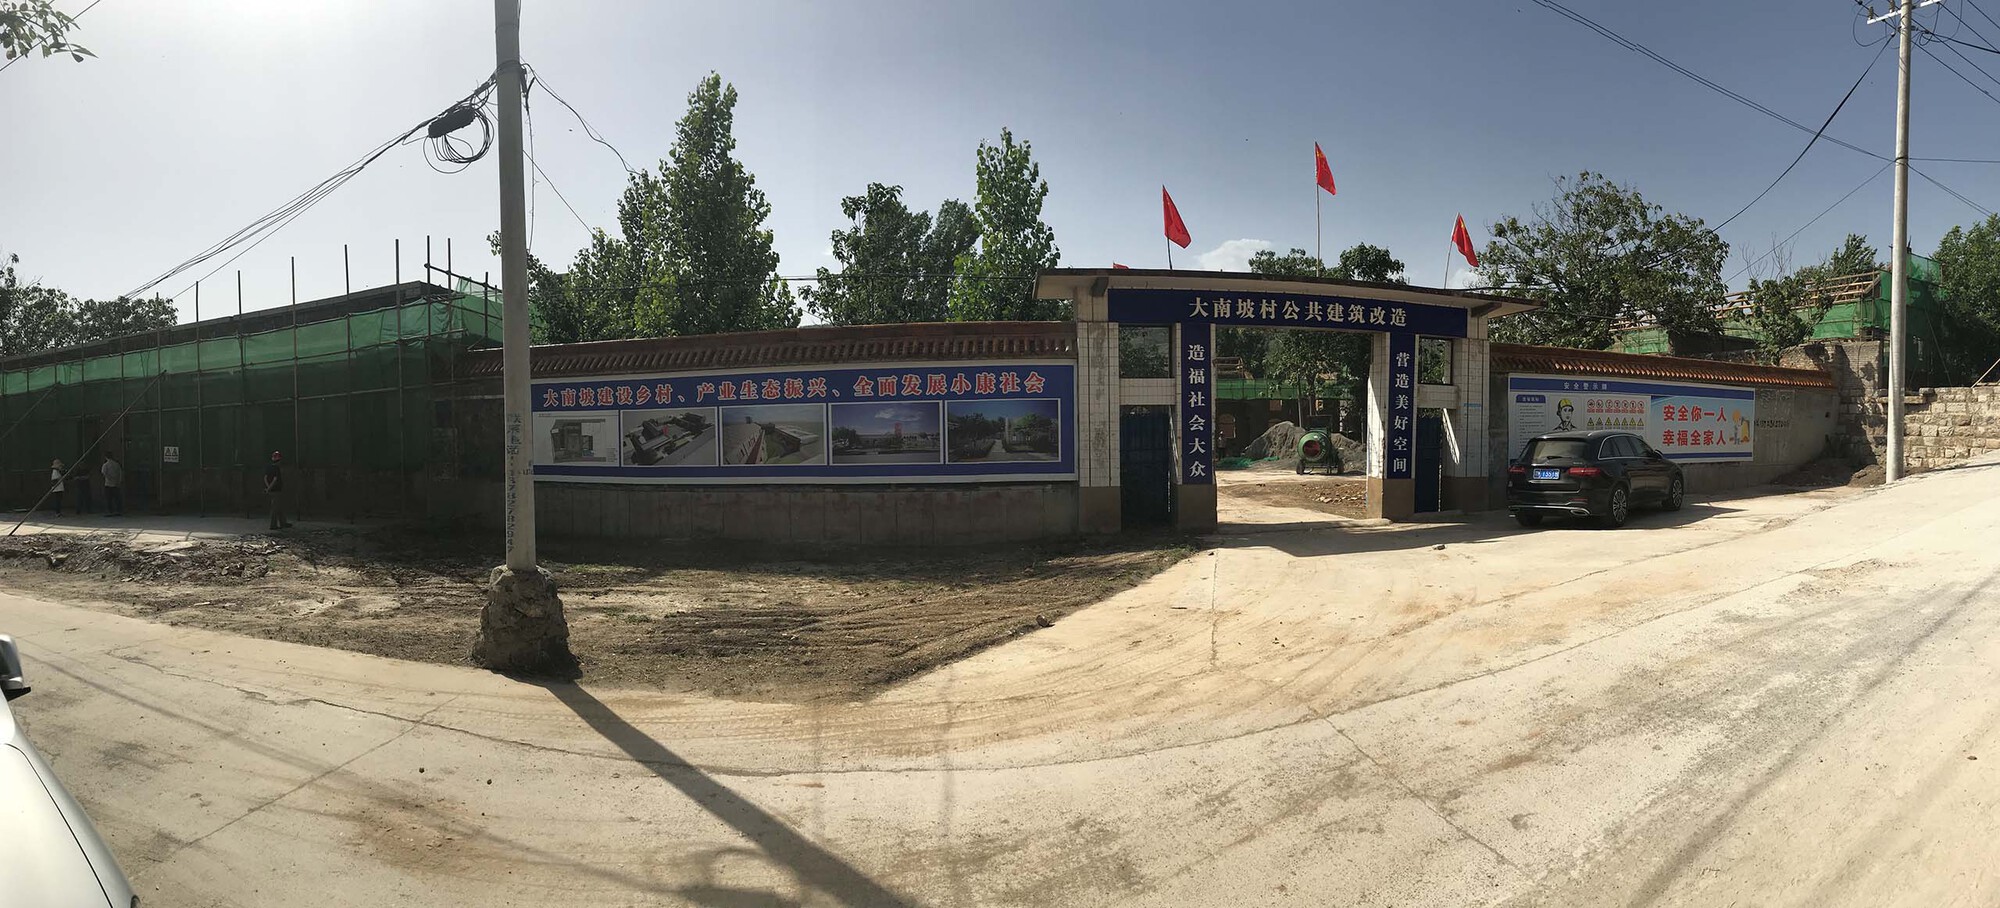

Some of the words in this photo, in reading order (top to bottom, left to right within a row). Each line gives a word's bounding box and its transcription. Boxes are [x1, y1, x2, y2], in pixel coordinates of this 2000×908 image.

[1188, 297, 1408, 328] 大南坡村公共建筑改造
[542, 371, 1047, 408] 大南坡建设乡村、产业生态振兴、全面发展小康社会
[1187, 344, 1206, 478] 造福社会大众
[1393, 351, 1410, 473] 营造美好空间
[1662, 404, 1728, 423] 安全你一人
[1661, 429, 1728, 447] 幸福全家人
